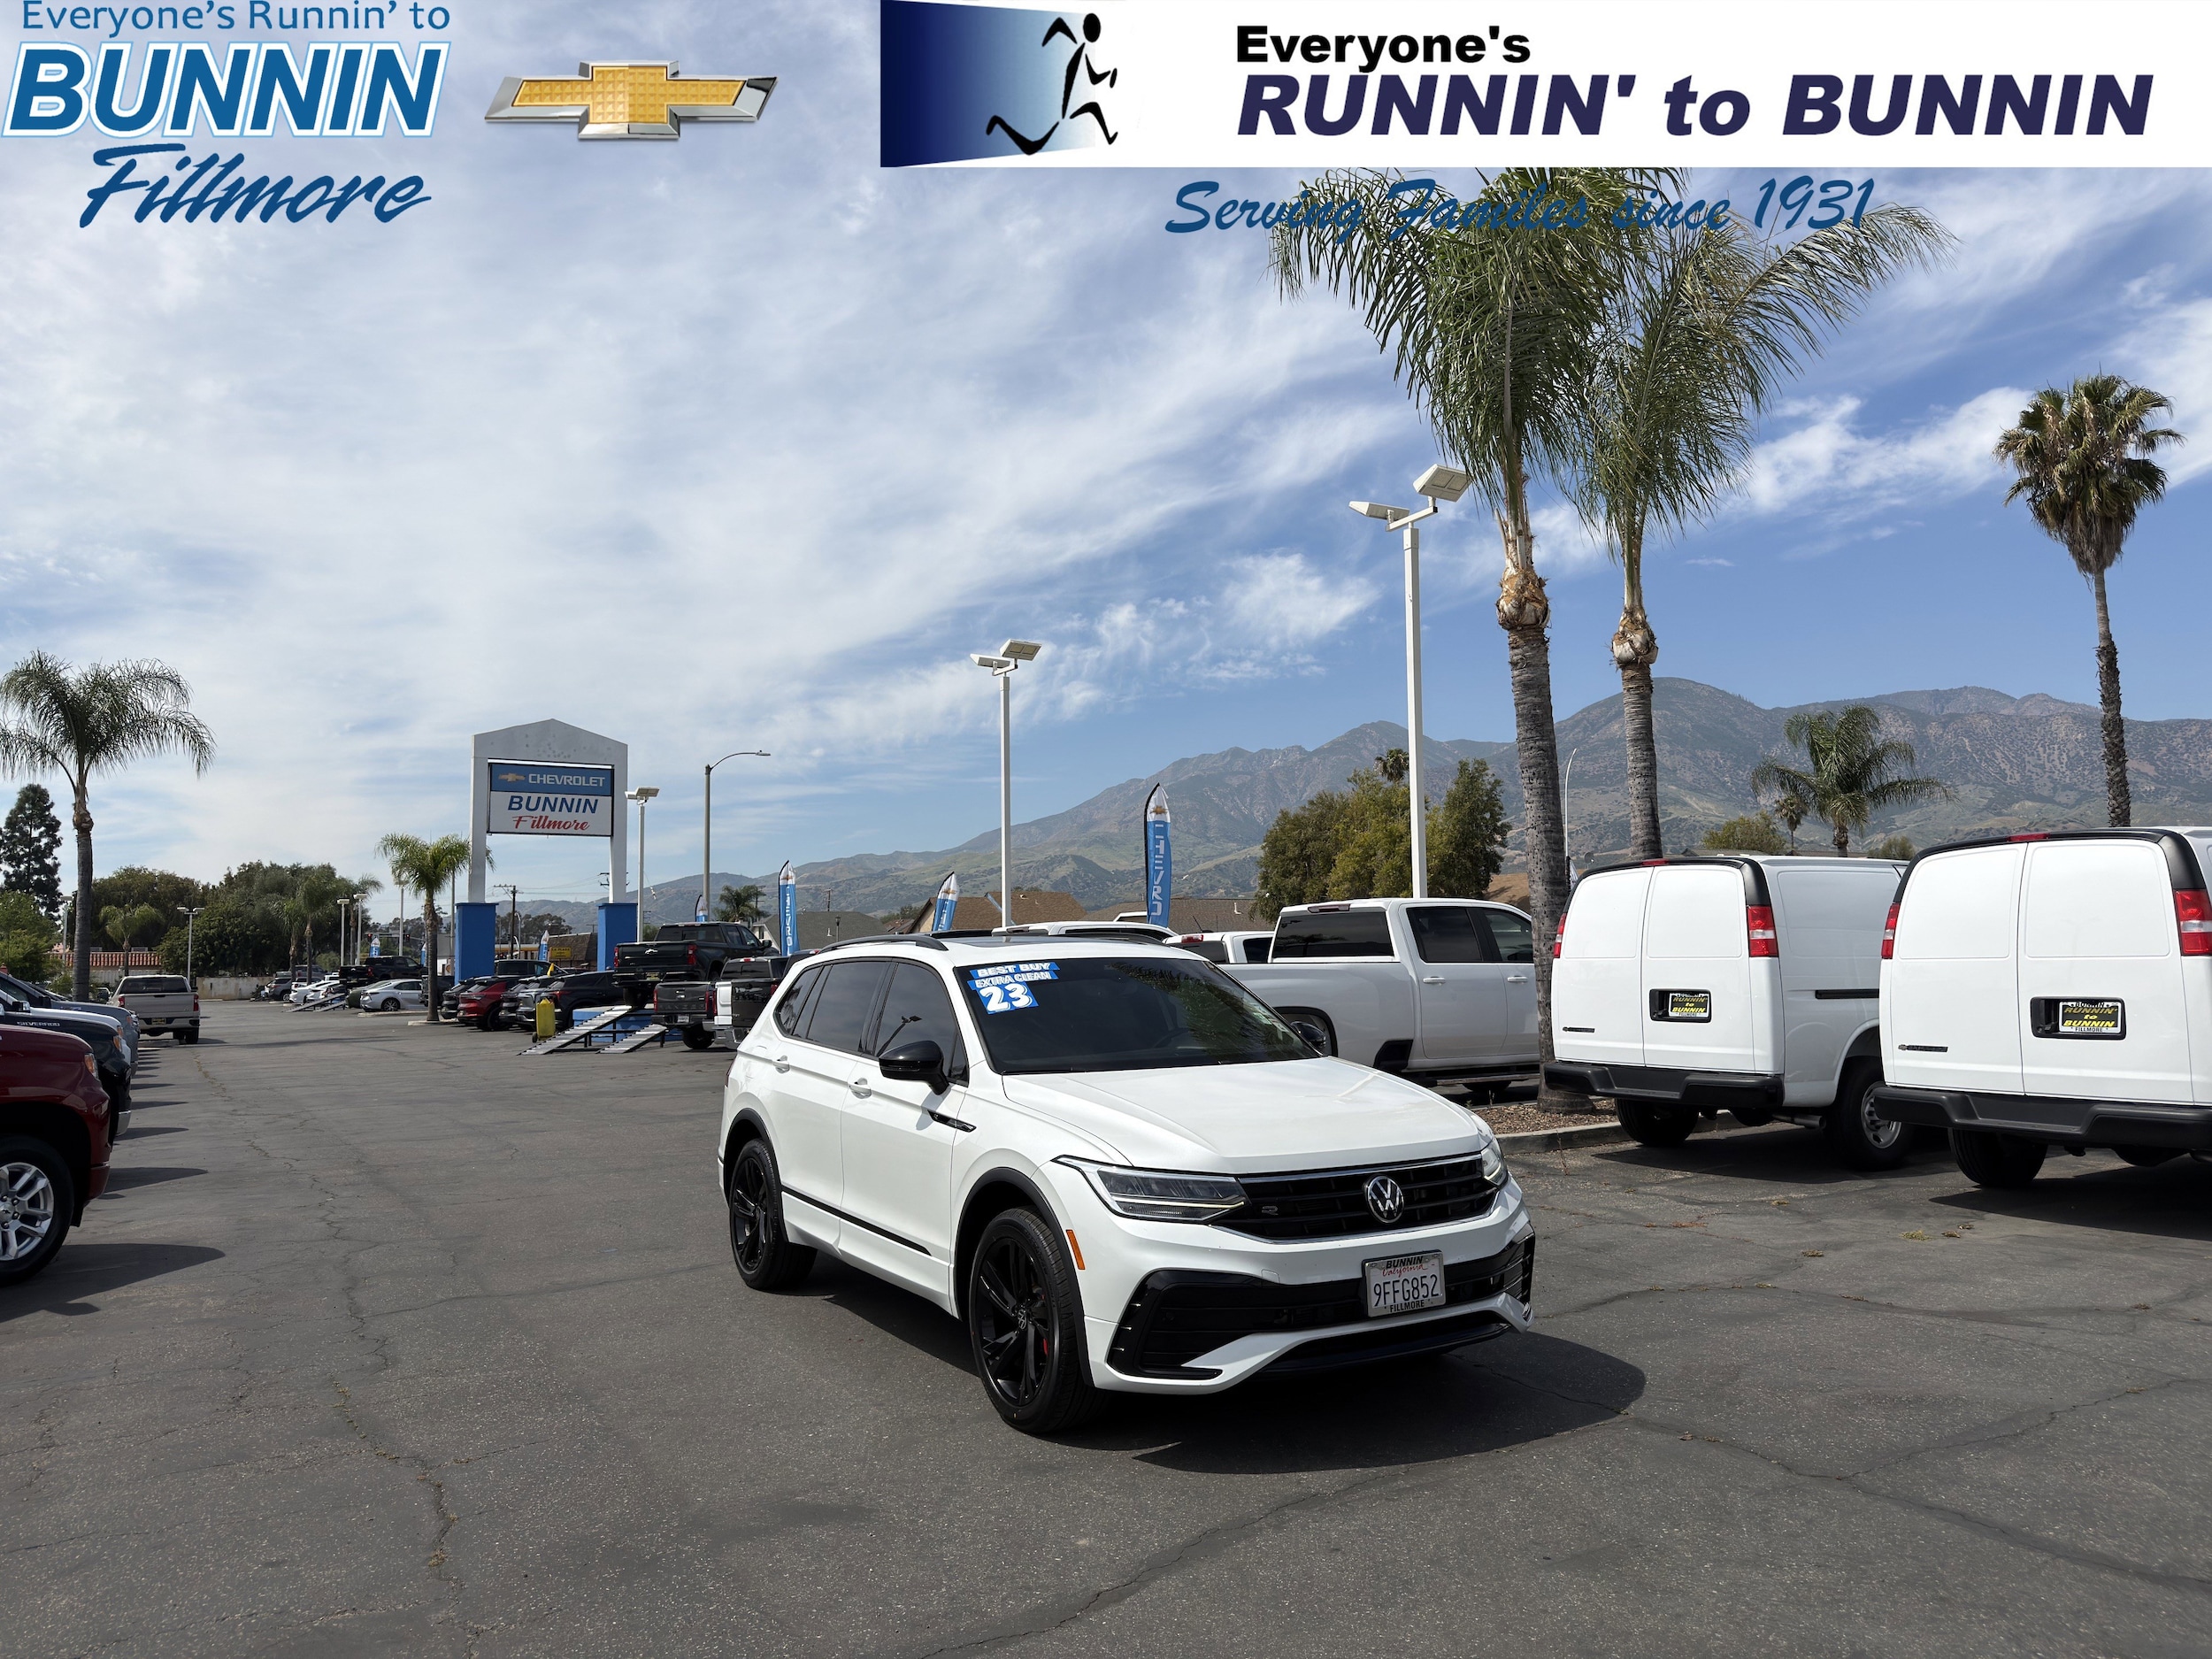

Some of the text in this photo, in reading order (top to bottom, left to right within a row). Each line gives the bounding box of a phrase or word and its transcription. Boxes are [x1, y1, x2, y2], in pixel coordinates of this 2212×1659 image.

[528, 773, 606, 787] CHEVROLET
[507, 795, 599, 814] BUNNIN
[511, 815, 591, 832] Fillmore
[978, 962, 1051, 978] BEST BUY
[975, 972, 1052, 988] EXTRA CLEAN
[979, 983, 1033, 1013] 23
[1382, 1263, 1428, 1278] California
[1386, 1256, 1424, 1269] BUNNIN
[1373, 1274, 1440, 1307] 9FFG852
[1390, 1300, 1425, 1313] FILLMORE
